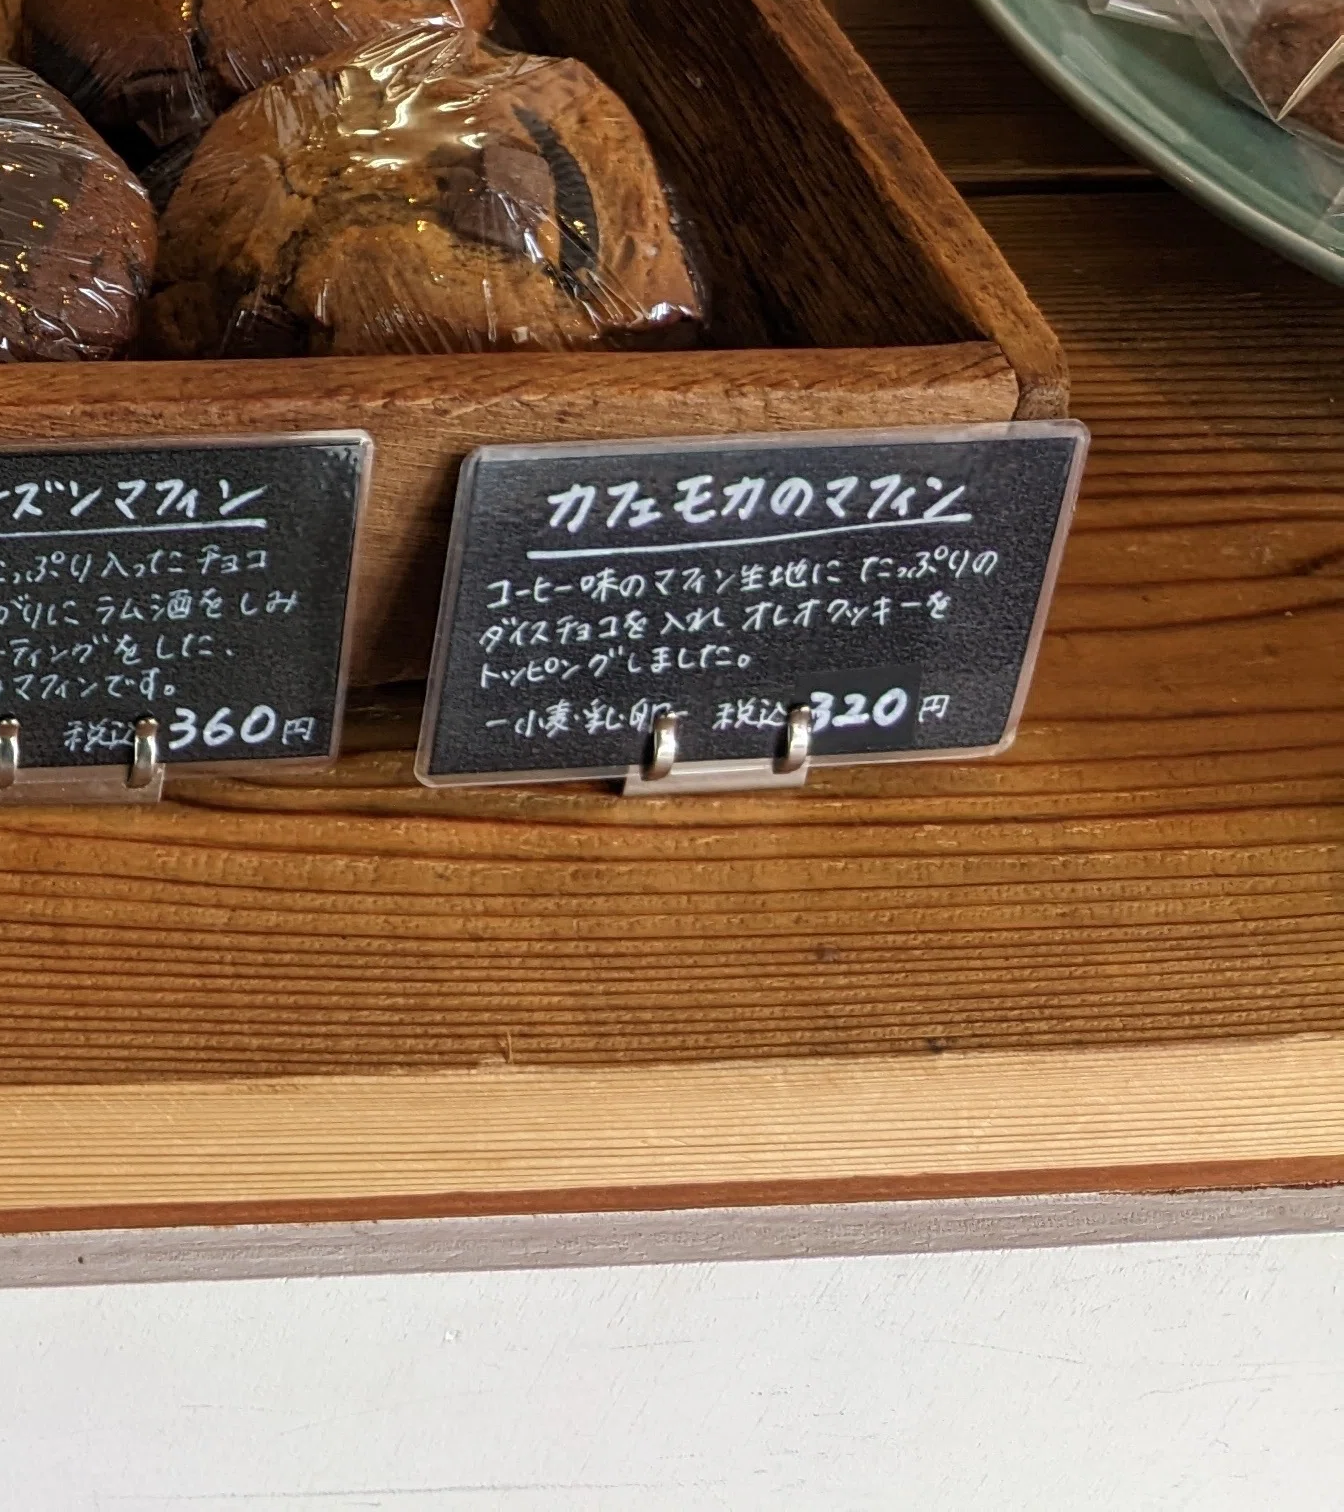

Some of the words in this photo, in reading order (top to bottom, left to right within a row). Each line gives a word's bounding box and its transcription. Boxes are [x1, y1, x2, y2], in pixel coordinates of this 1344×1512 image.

[547, 474, 968, 530] カフェモカのマフィン
[480, 645, 753, 689] トッピングしました。
